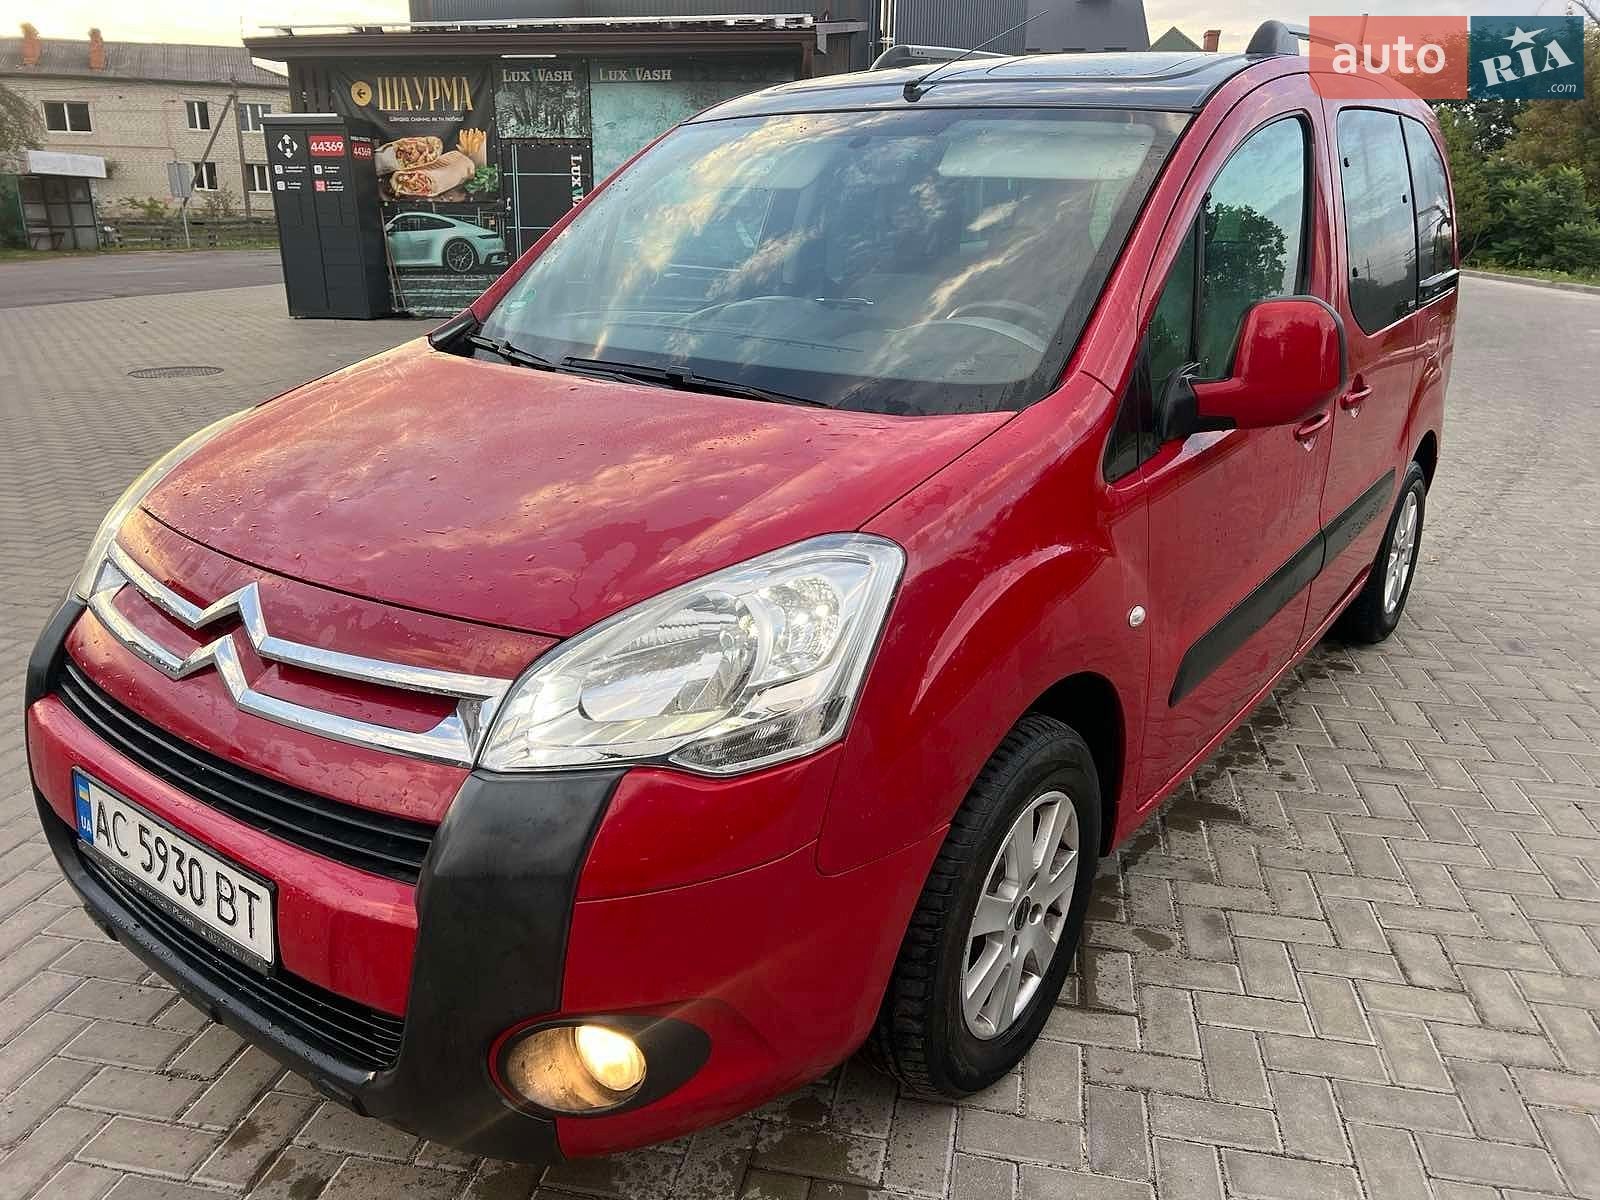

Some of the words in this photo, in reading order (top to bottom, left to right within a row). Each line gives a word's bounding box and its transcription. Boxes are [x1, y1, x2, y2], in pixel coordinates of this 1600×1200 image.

[502, 69, 530, 82] LUX
[599, 67, 628, 81] LUX
[377, 76, 474, 112] ШАУРМА
[310, 141, 344, 152] 44369
[570, 154, 583, 187] LUX
[80, 816, 92, 833] UA
[95, 799, 129, 857] AC
[138, 823, 205, 907] 5930
[215, 870, 262, 939] BT
